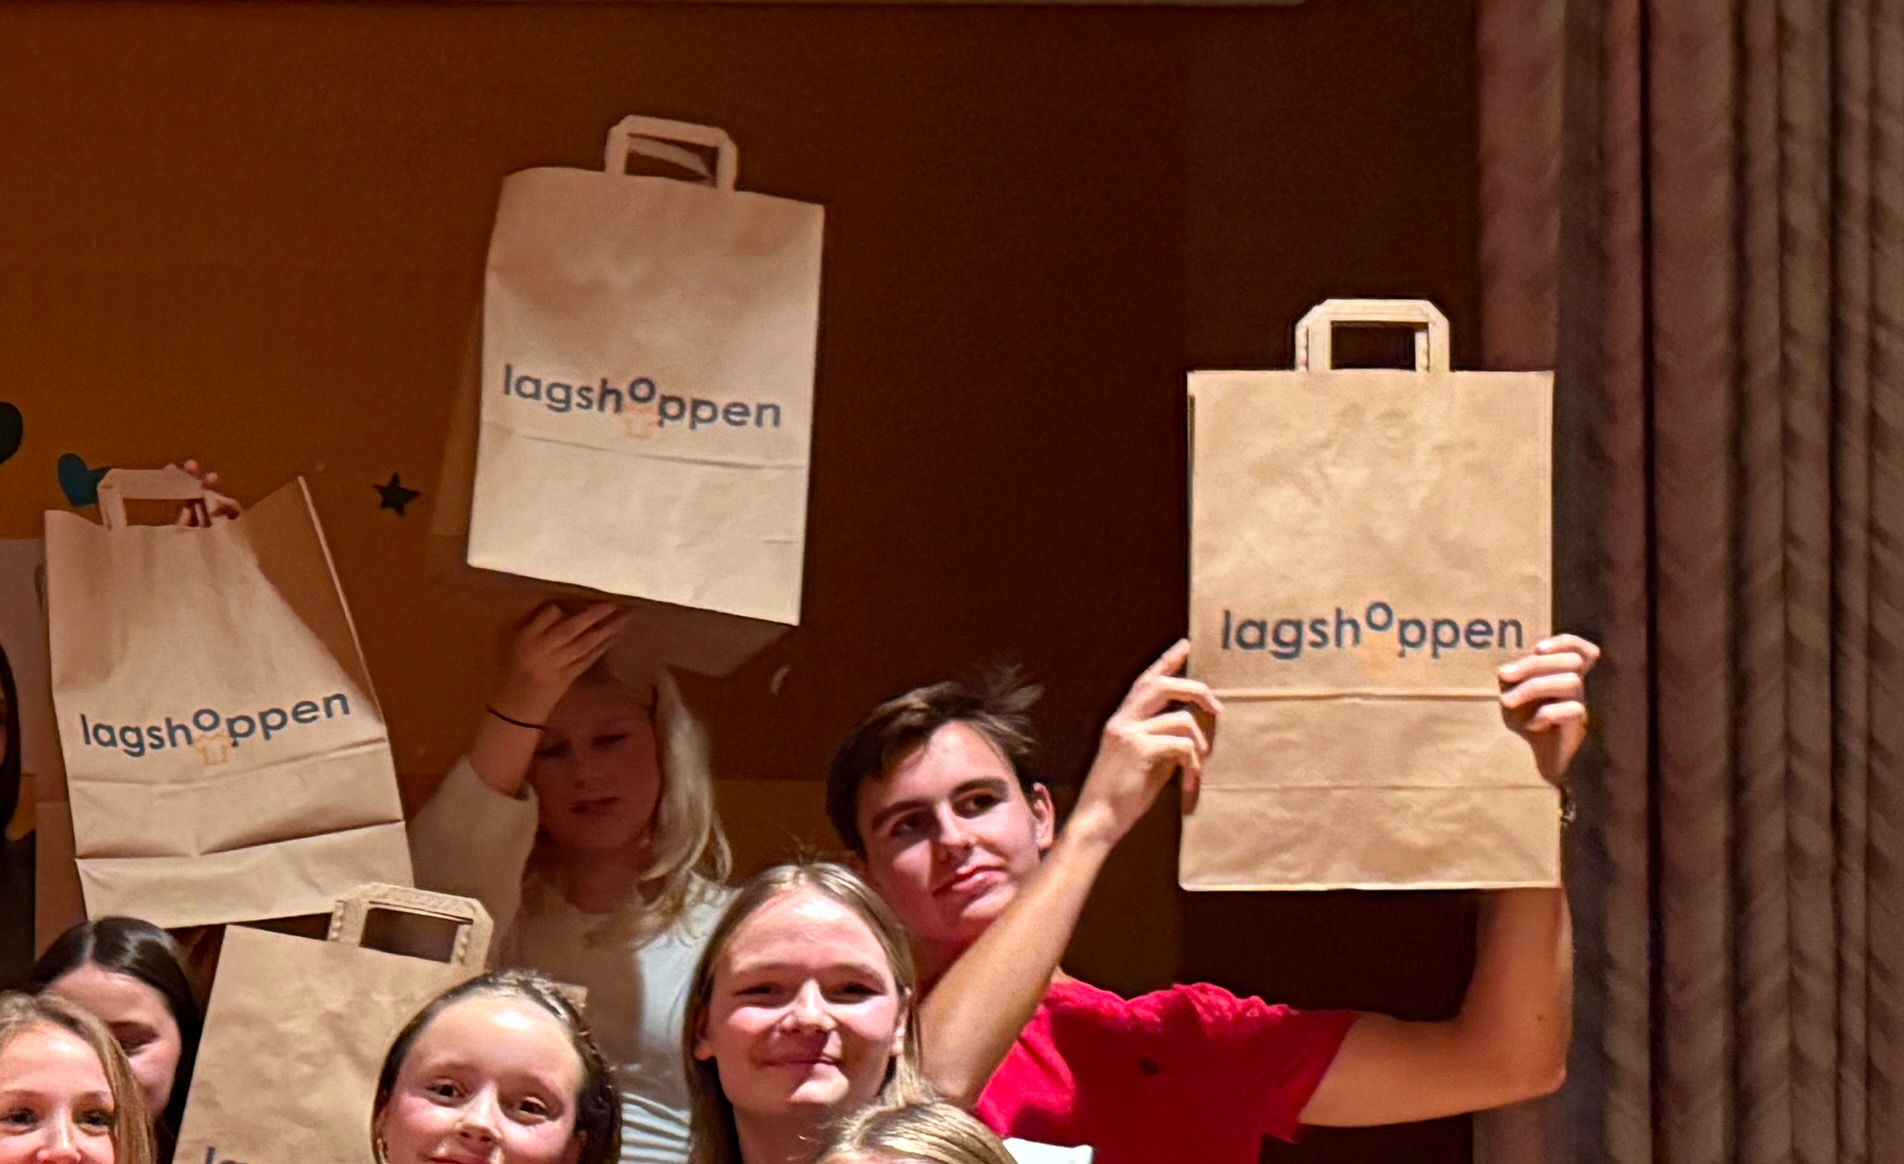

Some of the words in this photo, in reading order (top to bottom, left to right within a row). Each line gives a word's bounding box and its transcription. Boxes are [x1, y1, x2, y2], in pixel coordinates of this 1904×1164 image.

[503, 363, 782, 430] lagshoppen
[1221, 602, 1523, 660] lagshoppen
[80, 692, 351, 757] lagshoppen
